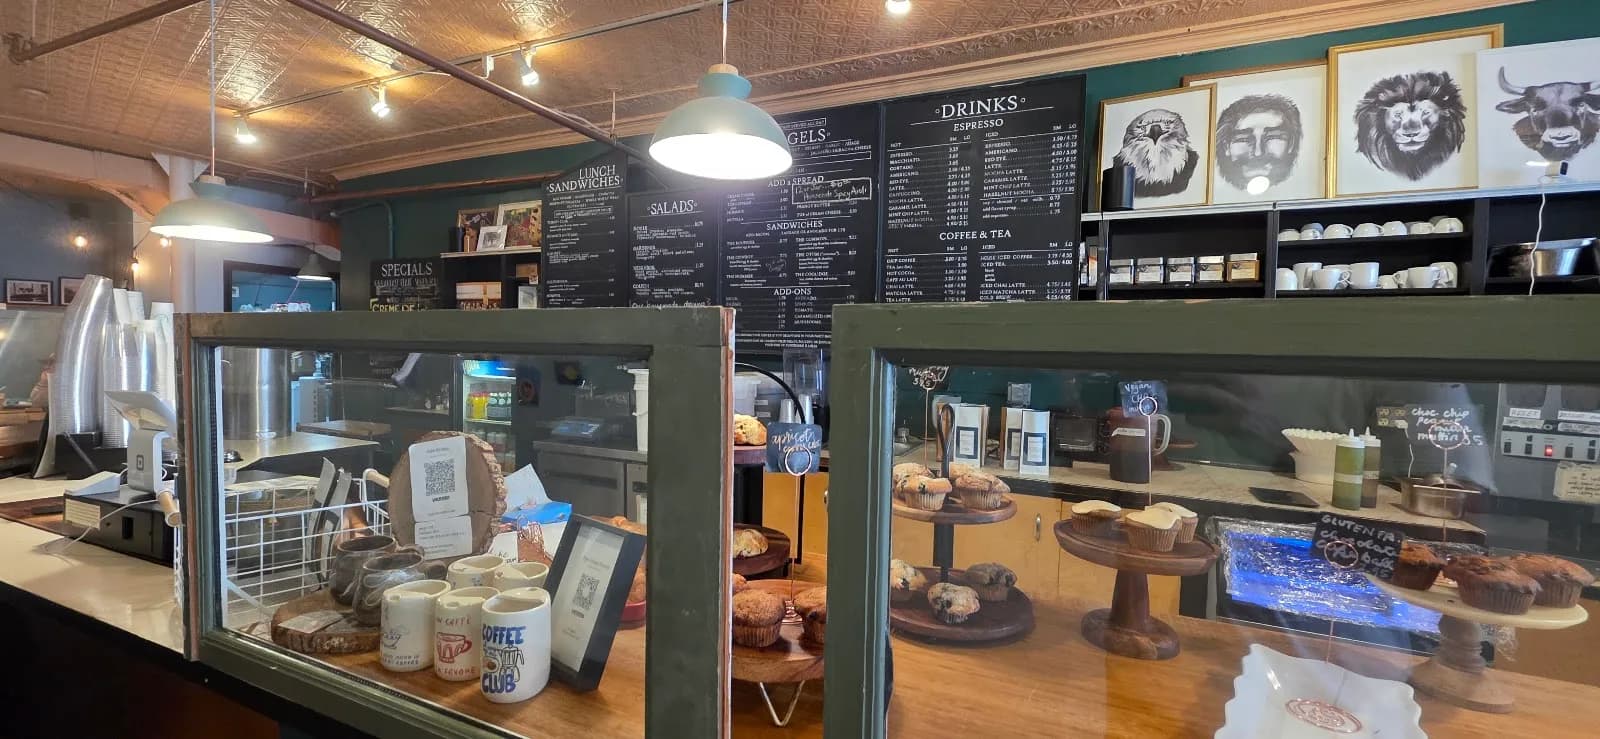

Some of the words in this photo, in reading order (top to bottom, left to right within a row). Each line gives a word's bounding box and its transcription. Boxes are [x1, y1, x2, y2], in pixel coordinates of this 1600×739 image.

[942, 95, 1018, 119] DRINKS
[954, 118, 1004, 132] ESPRESSO
[788, 128, 826, 145] GELS
[579, 164, 616, 180] LUNCH
[549, 175, 620, 193] SANDWICHES
[768, 179, 786, 188] ADD
[792, 175, 824, 185] SPREAD
[650, 199, 694, 215] SALADS
[766, 220, 823, 231] SANDWICHES
[939, 231, 978, 241] COFFEE
[979, 230, 988, 238] &
[990, 229, 1012, 238] TEA
[382, 262, 433, 277] SPECIALS
[774, 288, 812, 296] ADD-ONS
[1321, 514, 1376, 537] GLUTEN
[482, 624, 527, 645] COFFEE
[482, 672, 516, 694] CLUB
